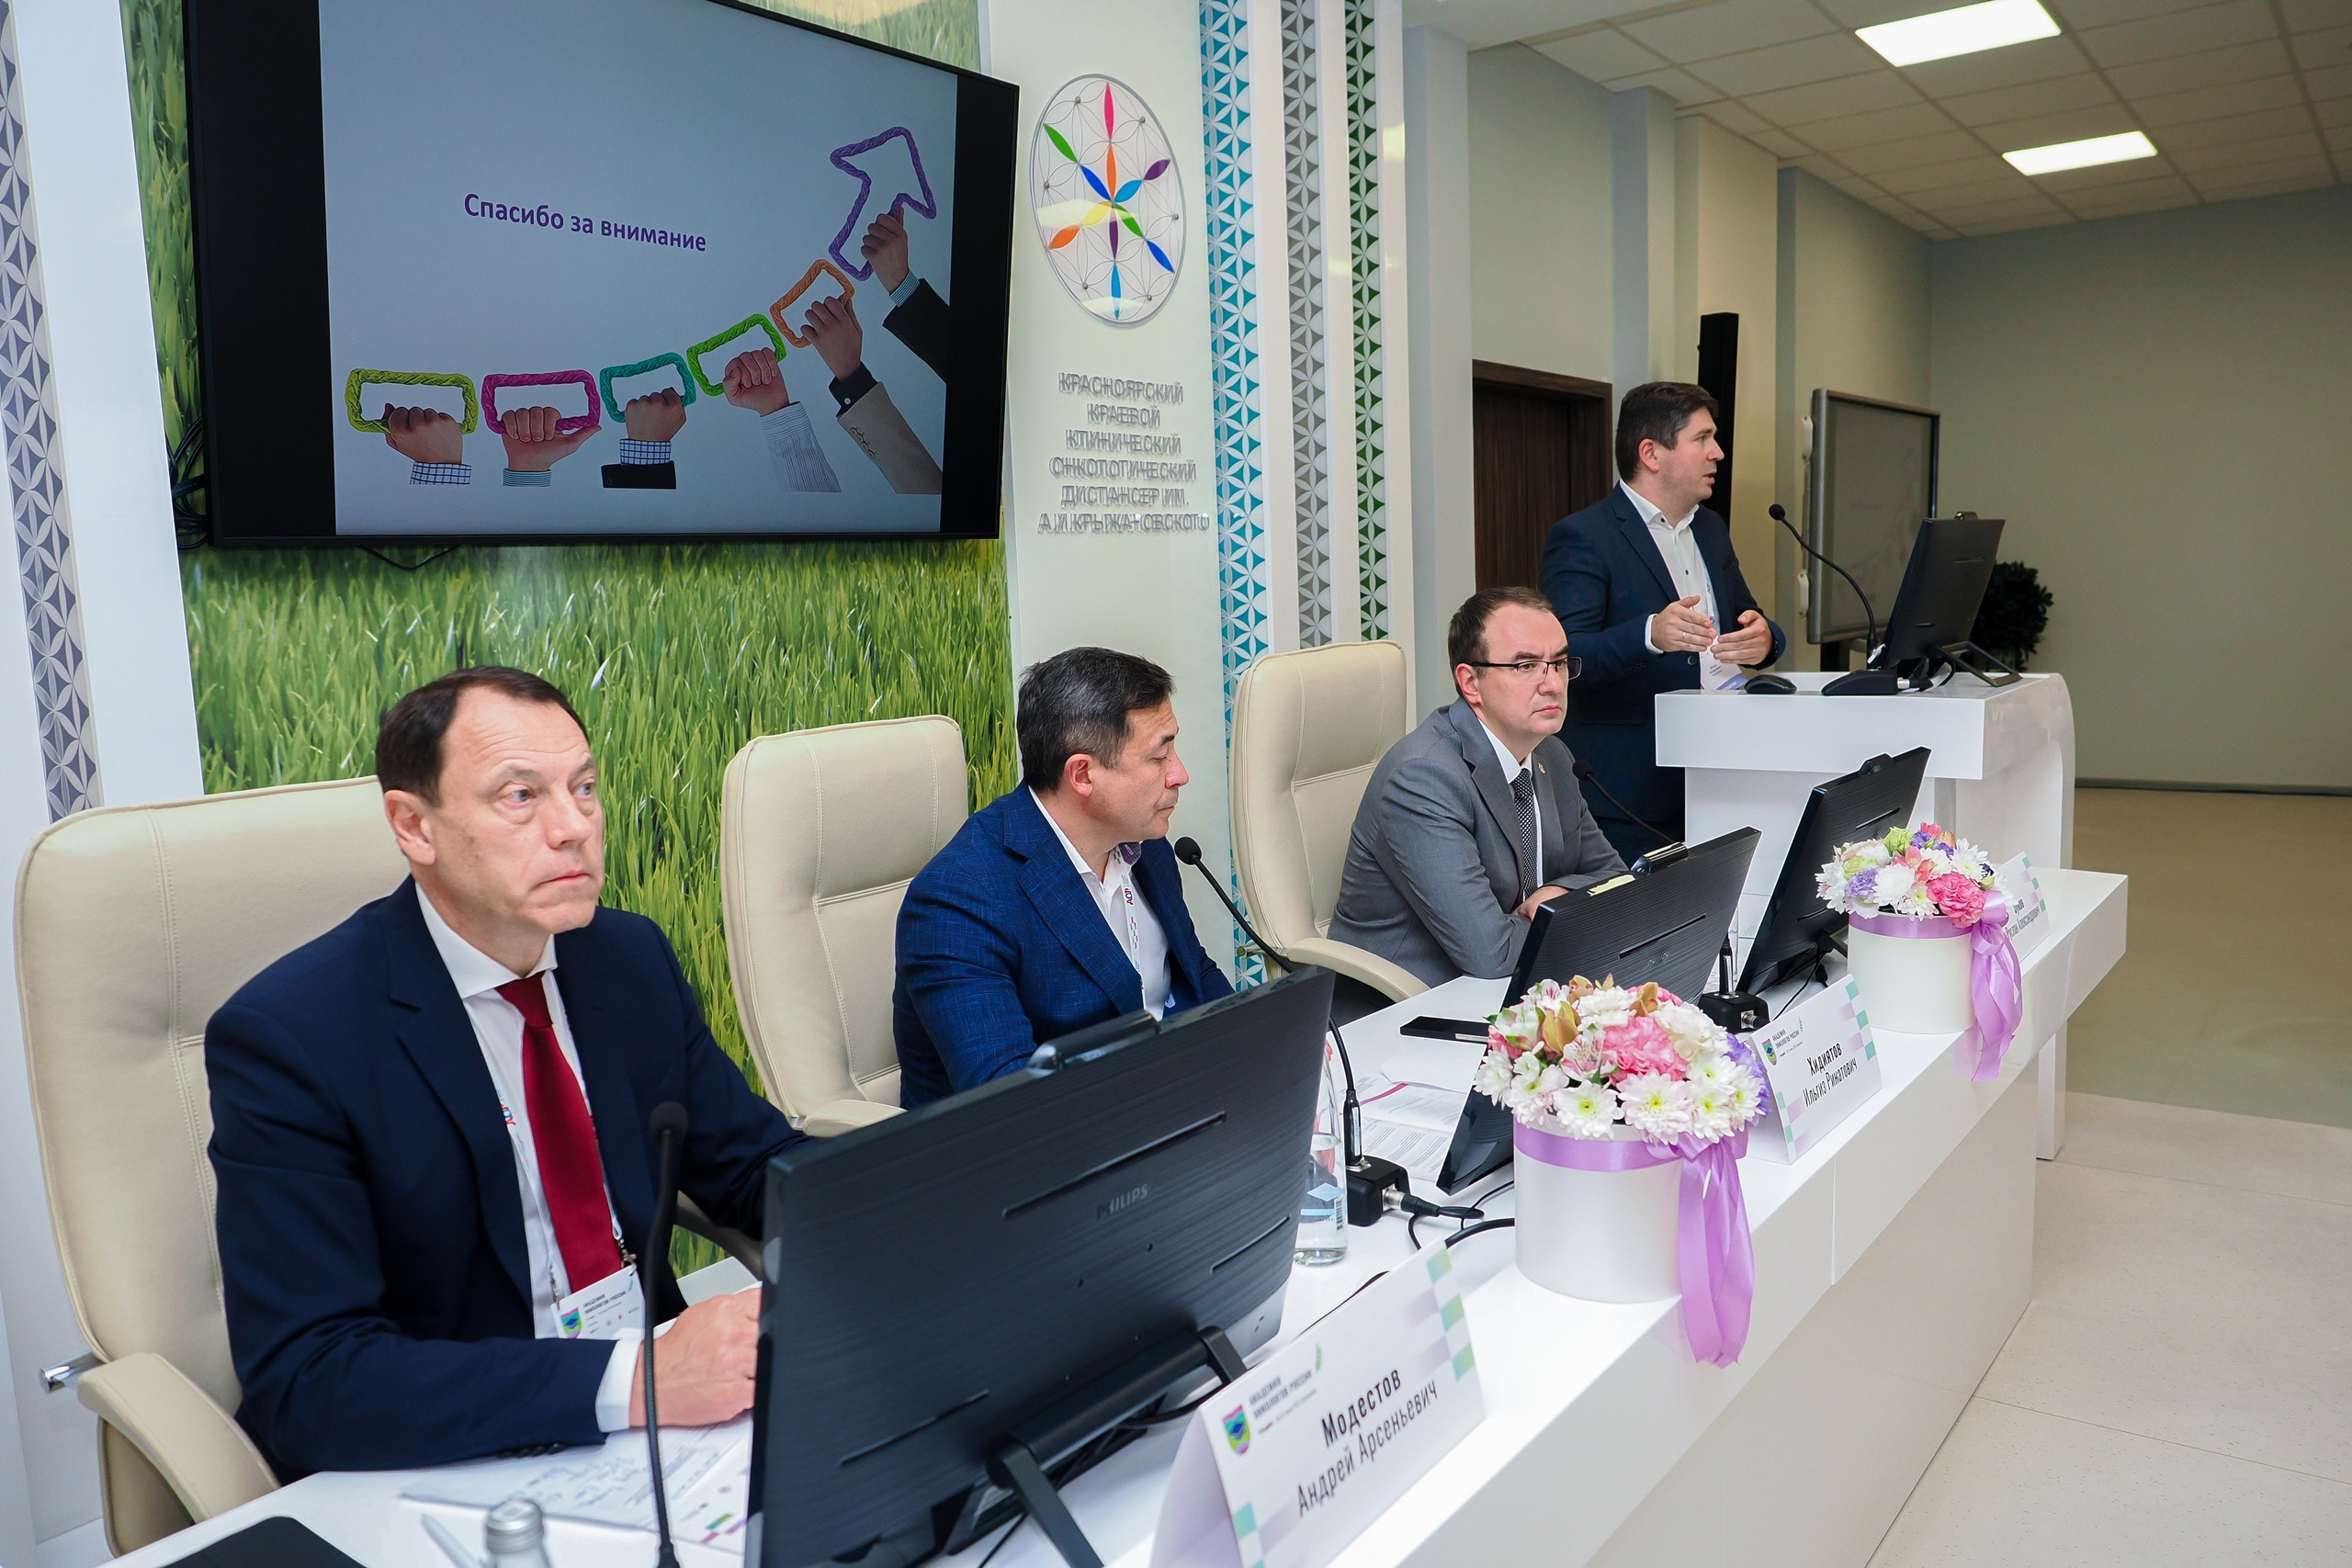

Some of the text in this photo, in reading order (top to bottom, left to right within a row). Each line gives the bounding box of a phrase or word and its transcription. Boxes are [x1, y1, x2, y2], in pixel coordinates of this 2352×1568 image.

[464, 193, 707, 252] Спасибо за внимание
[1058, 372, 1183, 404] КРАСНОЯРСКИЙ
[1086, 403, 1160, 428] КРАЕВОЙ
[1065, 429, 1182, 455] КЛИНИЧЕСКИЙ
[1048, 456, 1196, 481] ОНКОЛОГИЧЕСКИЙ
[1060, 485, 1190, 509] ДИСПАНСЕР ИМ.
[1806, 1043, 1843, 1077] Хидиятов
[1803, 1057, 1859, 1108] Ильгиз Ринатович
[1321, 1369, 1402, 1449] Модестов
[1297, 1380, 1439, 1517] Андрей Арсеньевич
